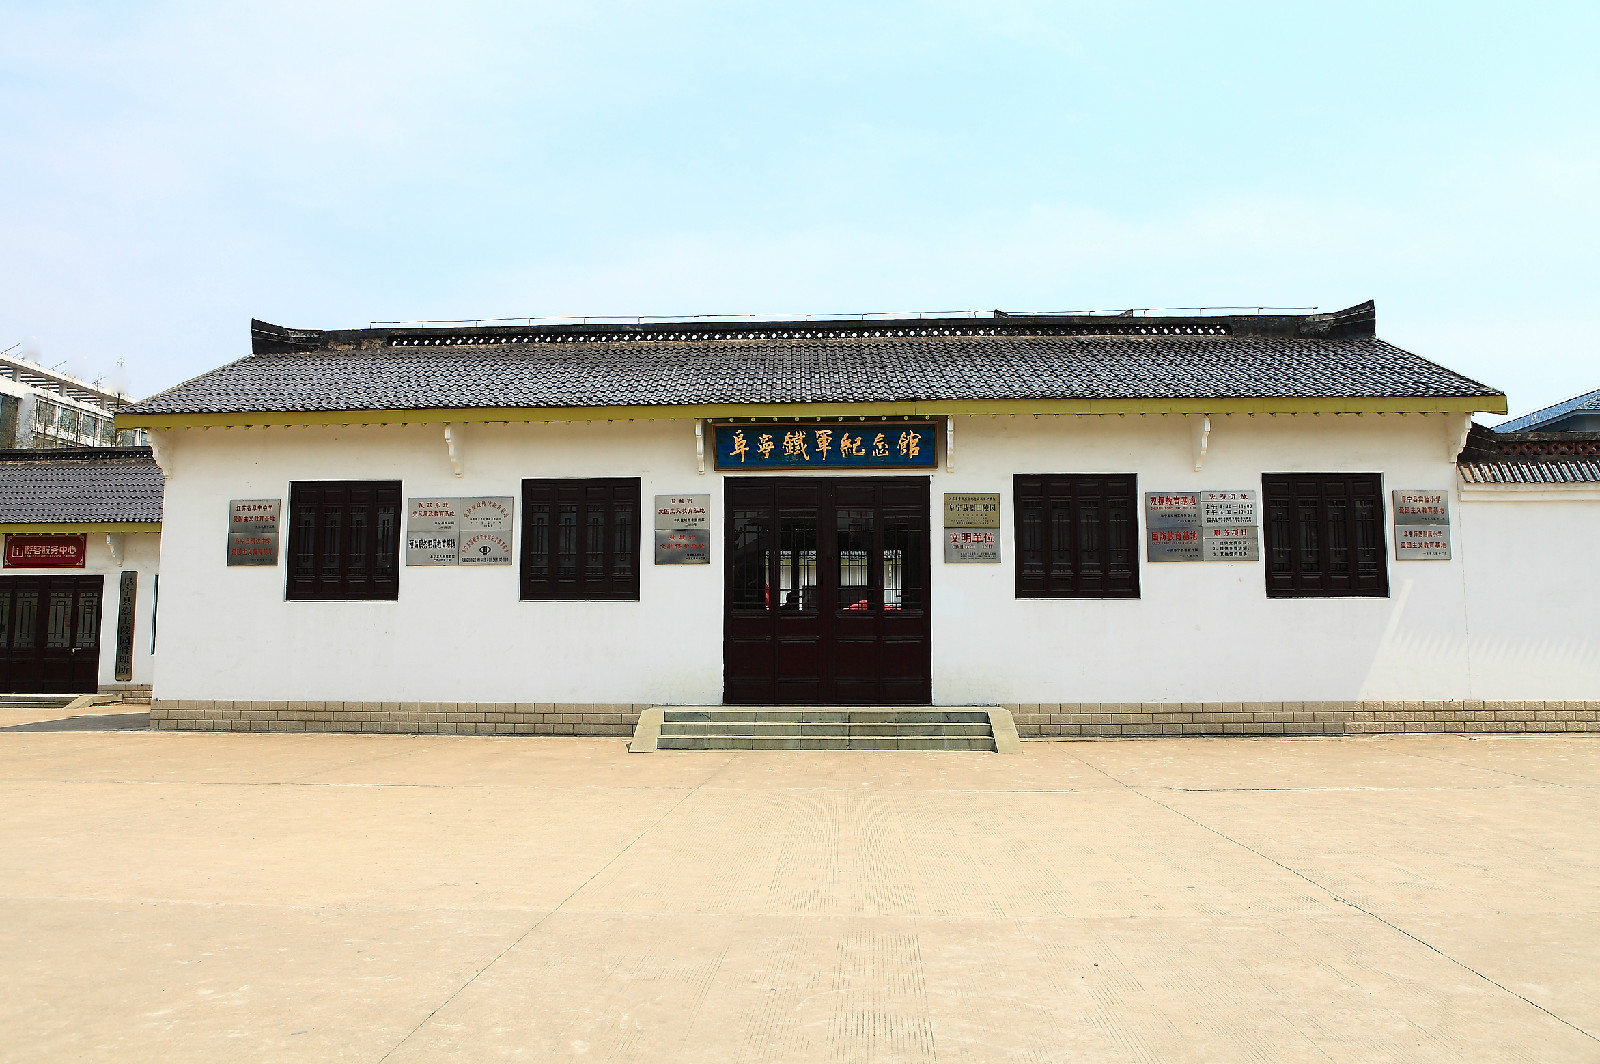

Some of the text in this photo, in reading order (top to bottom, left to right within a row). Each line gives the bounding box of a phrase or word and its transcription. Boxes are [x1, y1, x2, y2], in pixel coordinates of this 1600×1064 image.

[1150, 495, 1197, 505] 双拥教育基地
[1401, 495, 1441, 504] 阜宁县实验小学
[1399, 506, 1445, 515] 爱国主义教育基地
[233, 515, 276, 523] 爱国主义教育基地
[1151, 530, 1198, 541] 国防教育基地
[1213, 528, 1247, 536] 服务项目
[950, 532, 995, 544] 文明单位
[1400, 541, 1447, 549] 爱国主义教育基地
[24, 545, 77, 555] 游客服务中心
